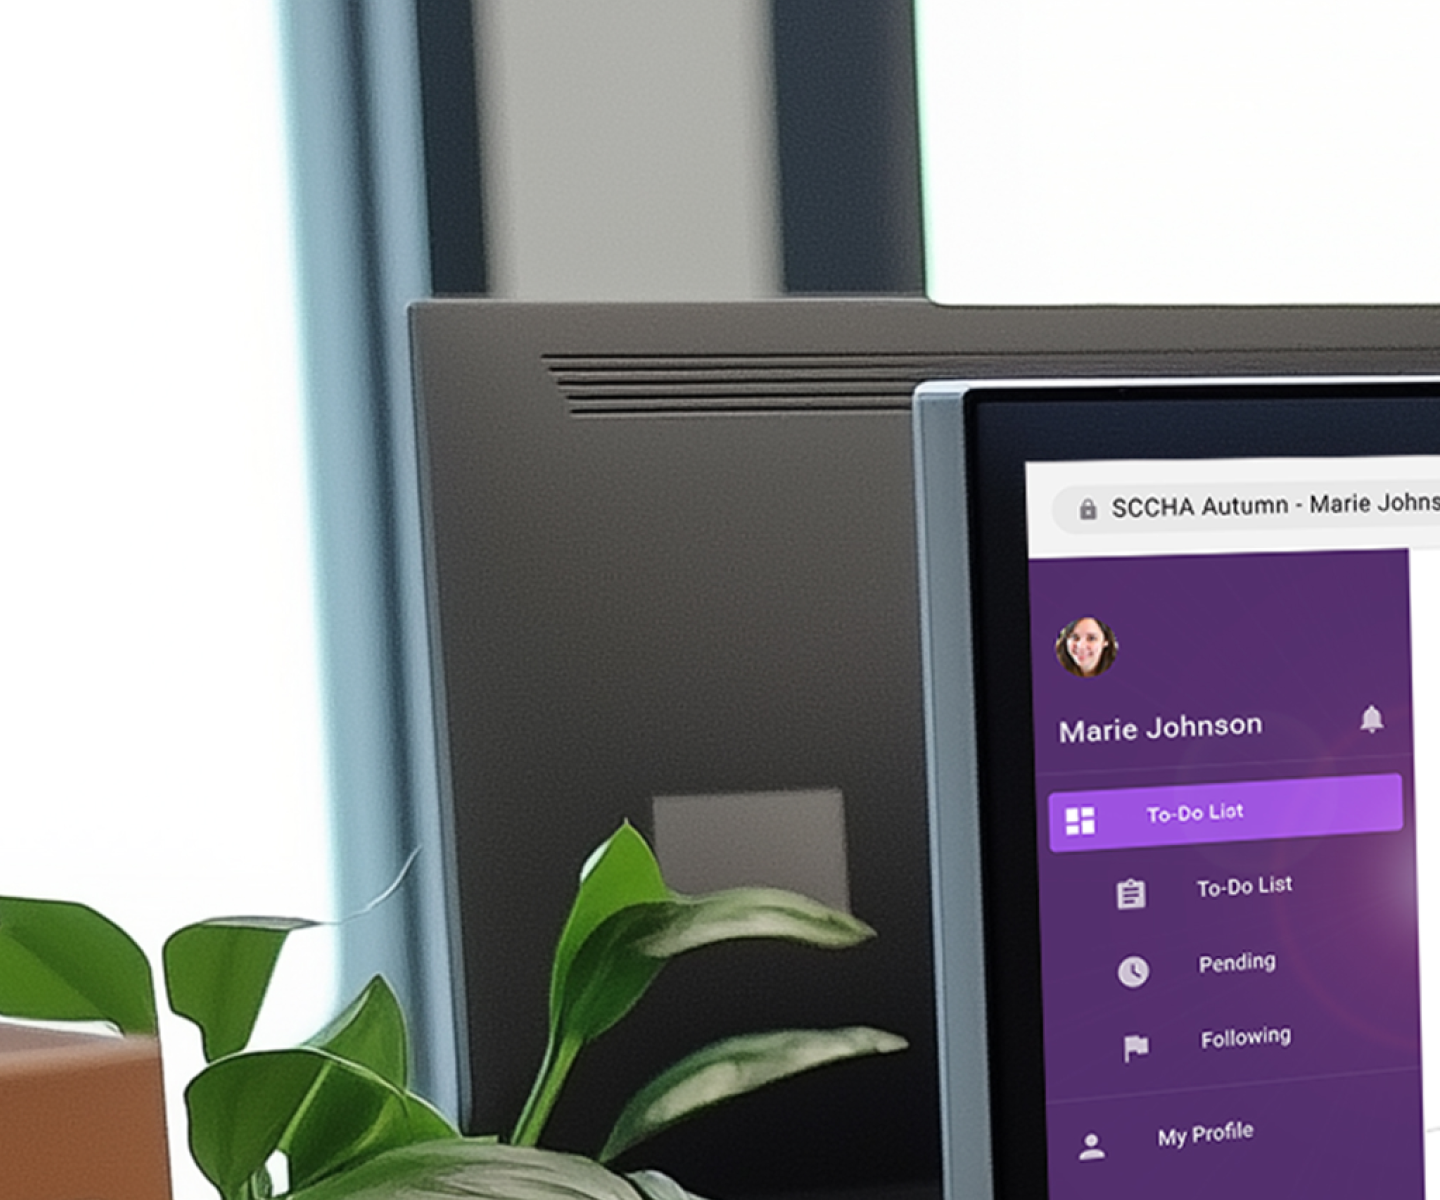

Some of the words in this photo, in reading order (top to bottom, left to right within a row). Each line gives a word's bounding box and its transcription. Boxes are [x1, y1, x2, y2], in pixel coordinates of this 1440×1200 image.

[1112, 496, 1196, 519] SCCHA
[1201, 496, 1289, 517] Autumn
[1310, 492, 1372, 514] Marie
[1059, 718, 1139, 744] Marie
[1145, 714, 1263, 739] Johnson
[1146, 804, 1205, 824] To-Do
[1208, 802, 1244, 820] List
[1196, 878, 1254, 898] To-Do
[1258, 875, 1293, 894] List
[1199, 951, 1276, 974] Pending
[1201, 1026, 1292, 1049] Following
[1158, 1128, 1188, 1150] My
[1192, 1120, 1254, 1143] Profile
